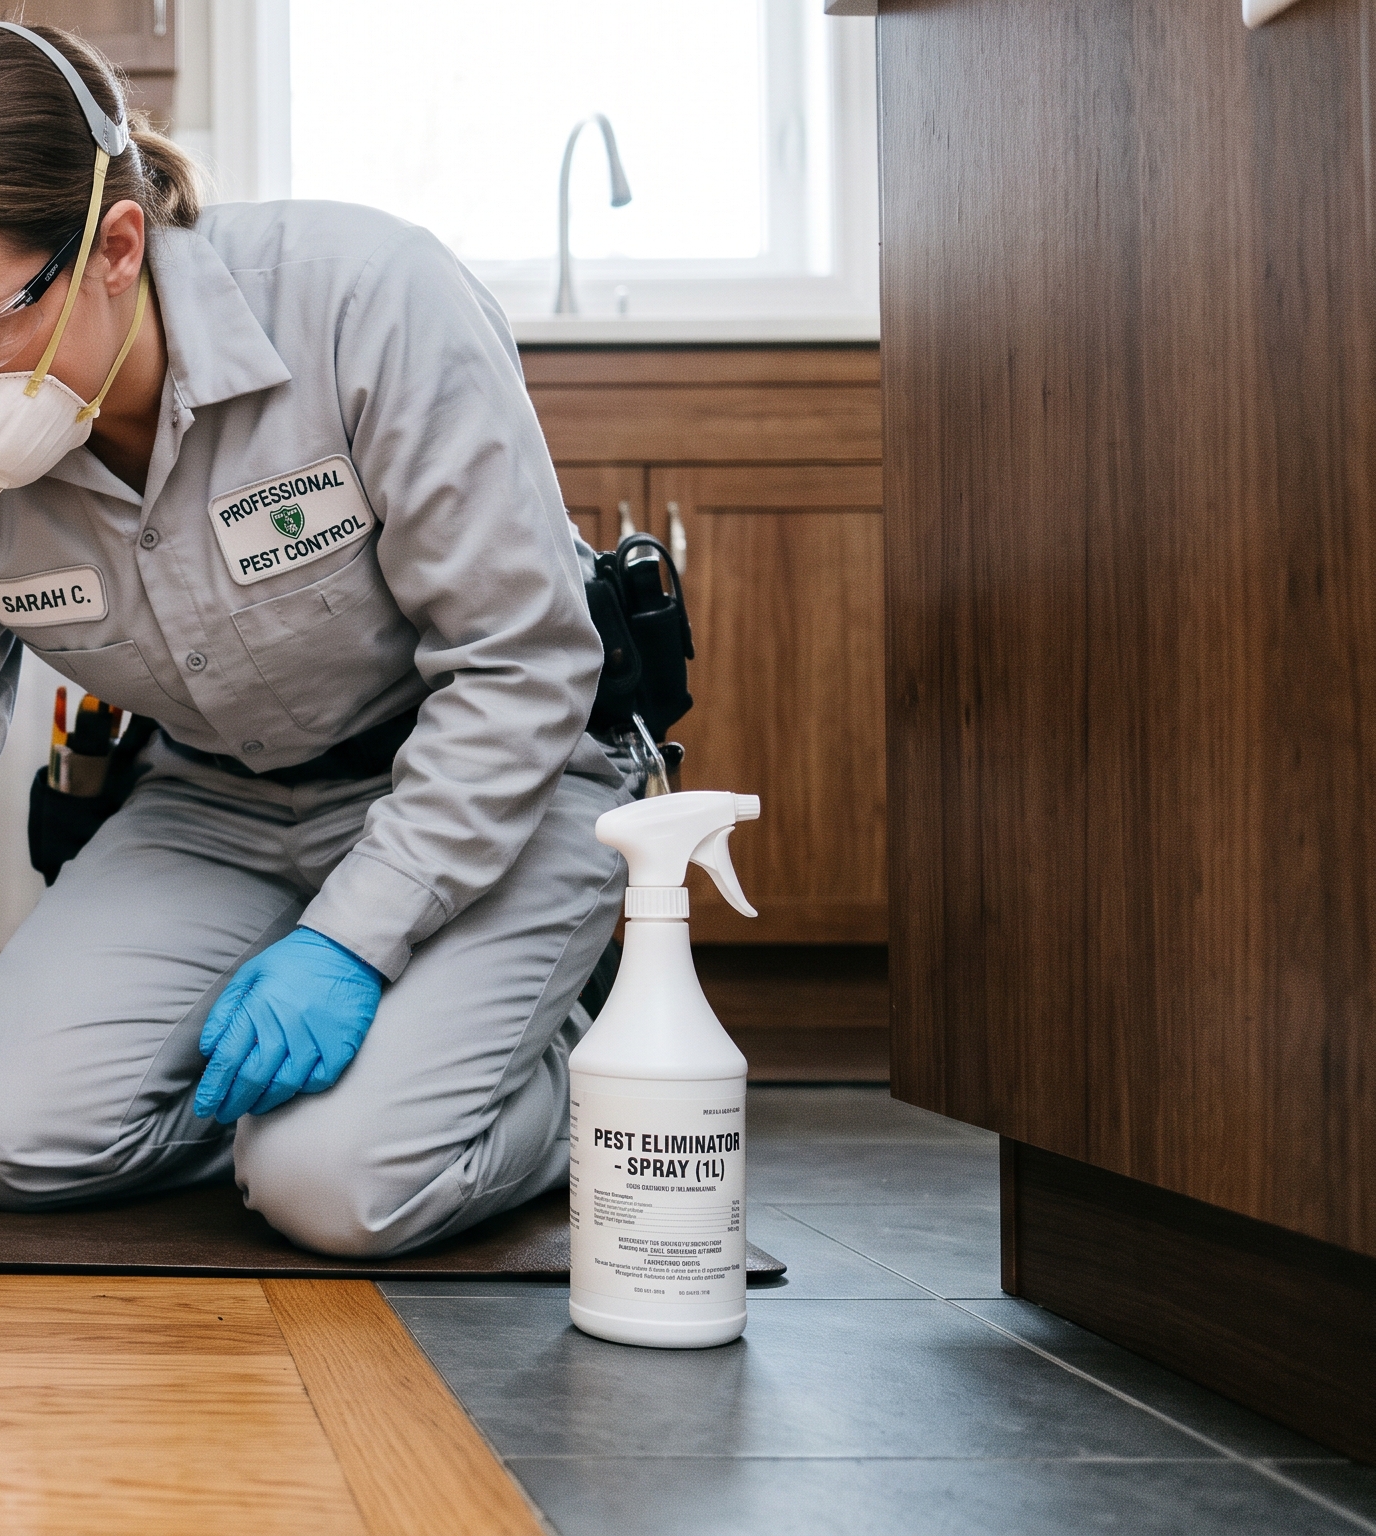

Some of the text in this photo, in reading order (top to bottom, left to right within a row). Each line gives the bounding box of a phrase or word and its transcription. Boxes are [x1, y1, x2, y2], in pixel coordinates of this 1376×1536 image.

[219, 470, 344, 528] PROFESSIONAL
[239, 515, 366, 575] PEST CONTROL
[1, 585, 91, 613] SARAH C.
[594, 1128, 635, 1151] PEST
[642, 1132, 740, 1154] ELIMINATOR
[627, 1157, 690, 1178] SPRAY
[695, 1158, 725, 1183] (1L)
